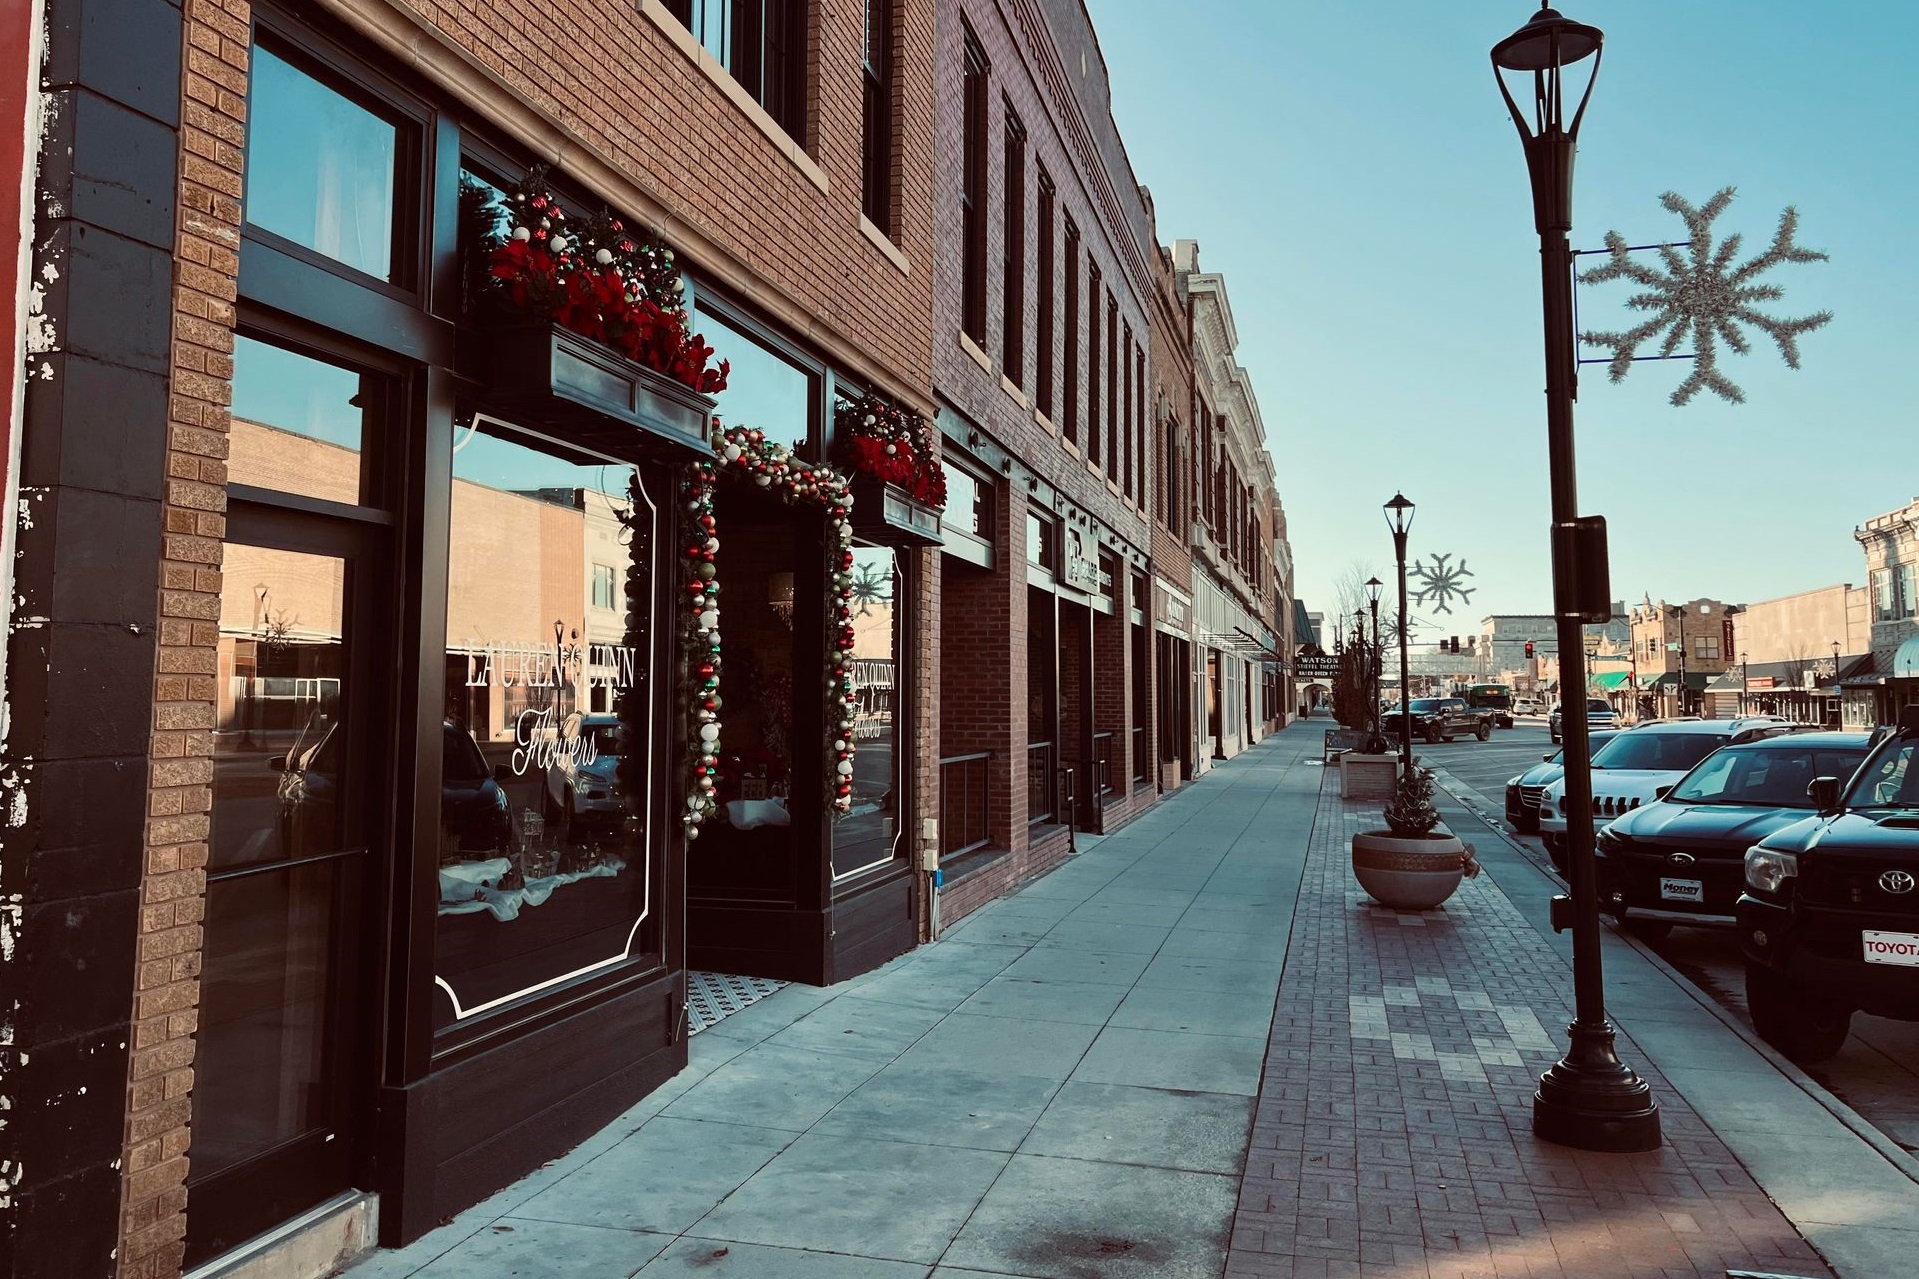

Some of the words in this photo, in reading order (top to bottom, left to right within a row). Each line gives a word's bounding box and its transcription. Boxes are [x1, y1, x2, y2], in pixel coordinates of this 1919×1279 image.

[465, 639, 564, 688] LAUREN
[570, 643, 637, 698] QUINN
[869, 662, 895, 693] QUINN
[511, 706, 599, 776] Flowers
[1663, 882, 1700, 895] Money
